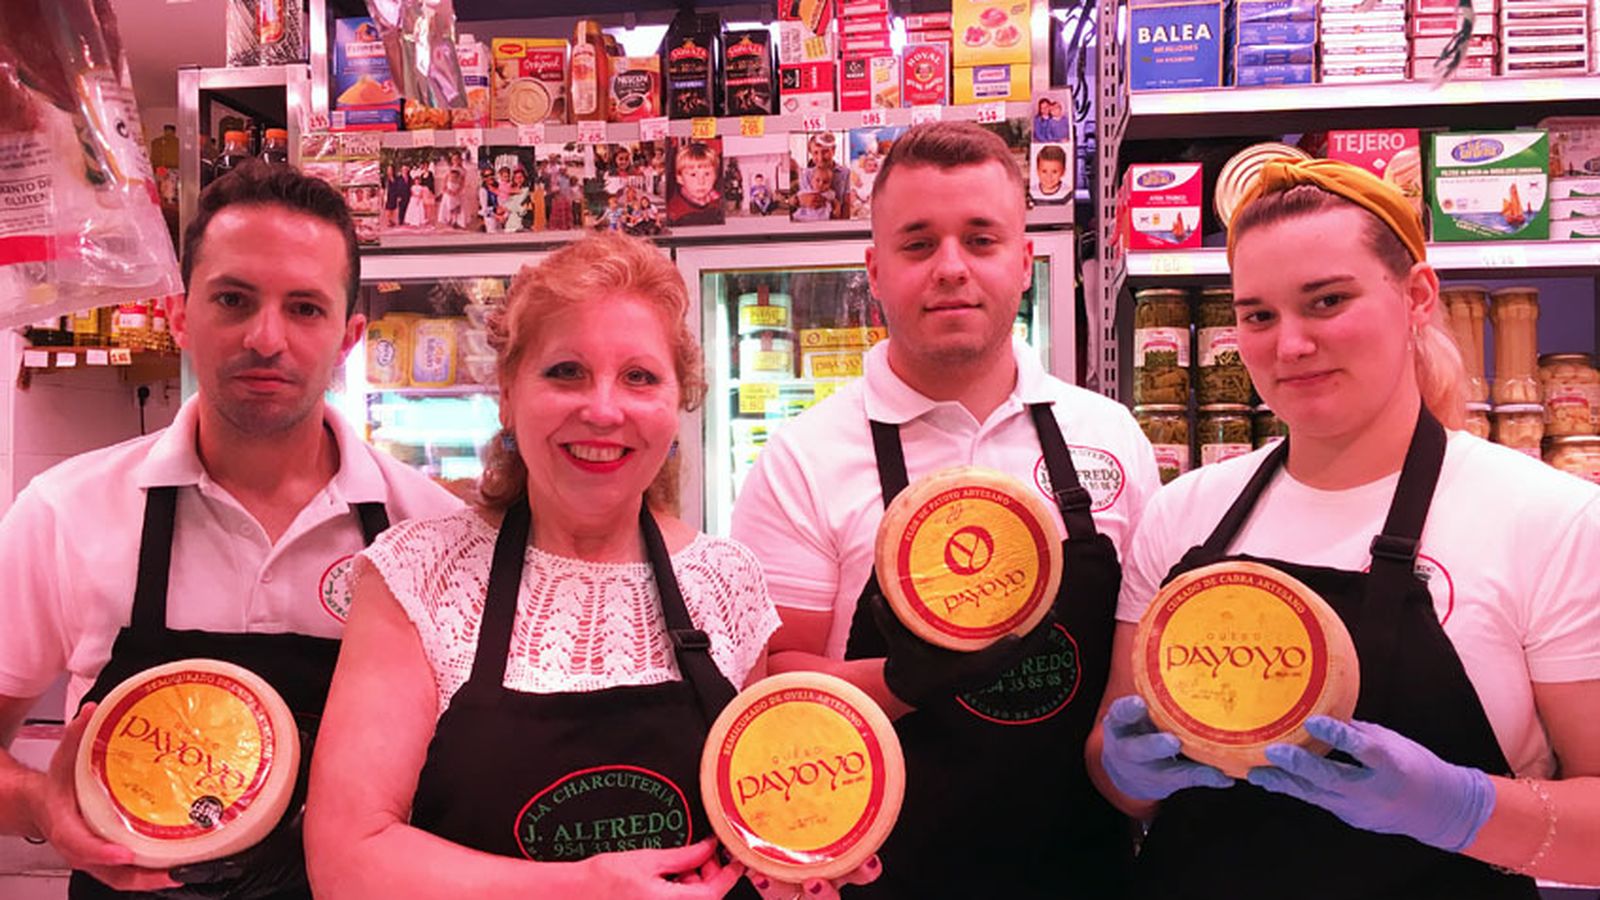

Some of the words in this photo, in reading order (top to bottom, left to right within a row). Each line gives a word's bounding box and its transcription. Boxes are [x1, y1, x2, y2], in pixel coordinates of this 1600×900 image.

[1138, 24, 1212, 44] BALEA
[1333, 133, 1406, 153] TEJERO
[961, 488, 1011, 506] ARTESANO
[944, 569, 1026, 613] PAYOYO
[1164, 581, 1204, 615] CURADO
[1201, 575, 1218, 590] DE
[1218, 572, 1255, 585] CABRA
[1256, 575, 1309, 614] ARTESANO
[1167, 645, 1306, 680] PAYOYO
[721, 699, 768, 756] SEMICURADO
[767, 693, 782, 706] DE
[815, 691, 865, 728] ARTESANO
[119, 715, 245, 791] PAYOYO
[528, 803, 551, 822] LA
[553, 772, 677, 806] CHARCUTERIA
[736, 751, 866, 806] PAYOYO
[524, 824, 543, 844] J.
[554, 810, 683, 843] ALFREDO
[553, 841, 584, 858] 954
[643, 836, 662, 850] 08
